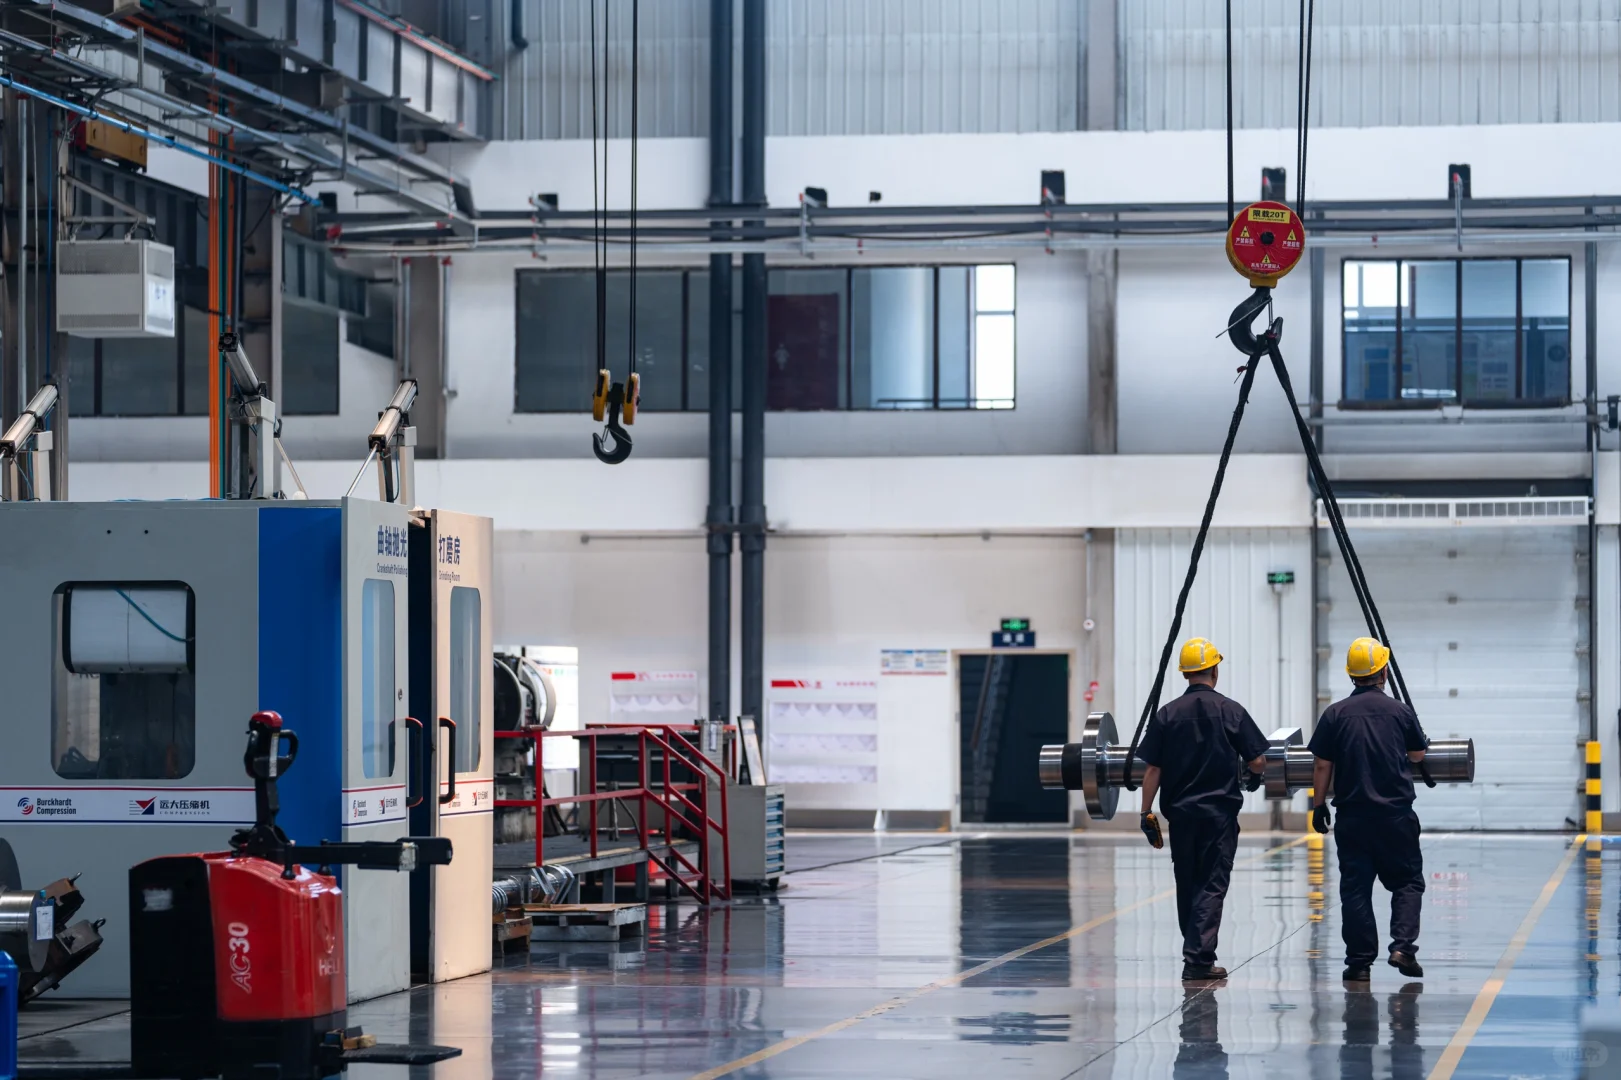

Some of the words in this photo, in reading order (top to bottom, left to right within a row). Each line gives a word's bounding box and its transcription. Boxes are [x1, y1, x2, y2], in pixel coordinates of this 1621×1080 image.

[1253, 209, 1285, 218] 限载20T
[378, 525, 407, 557] 曲轴抛光
[439, 534, 461, 565] 打磨房
[37, 797, 72, 806] Burckhardt
[159, 799, 210, 809] 远大压缩机
[37, 806, 77, 816] Compression
